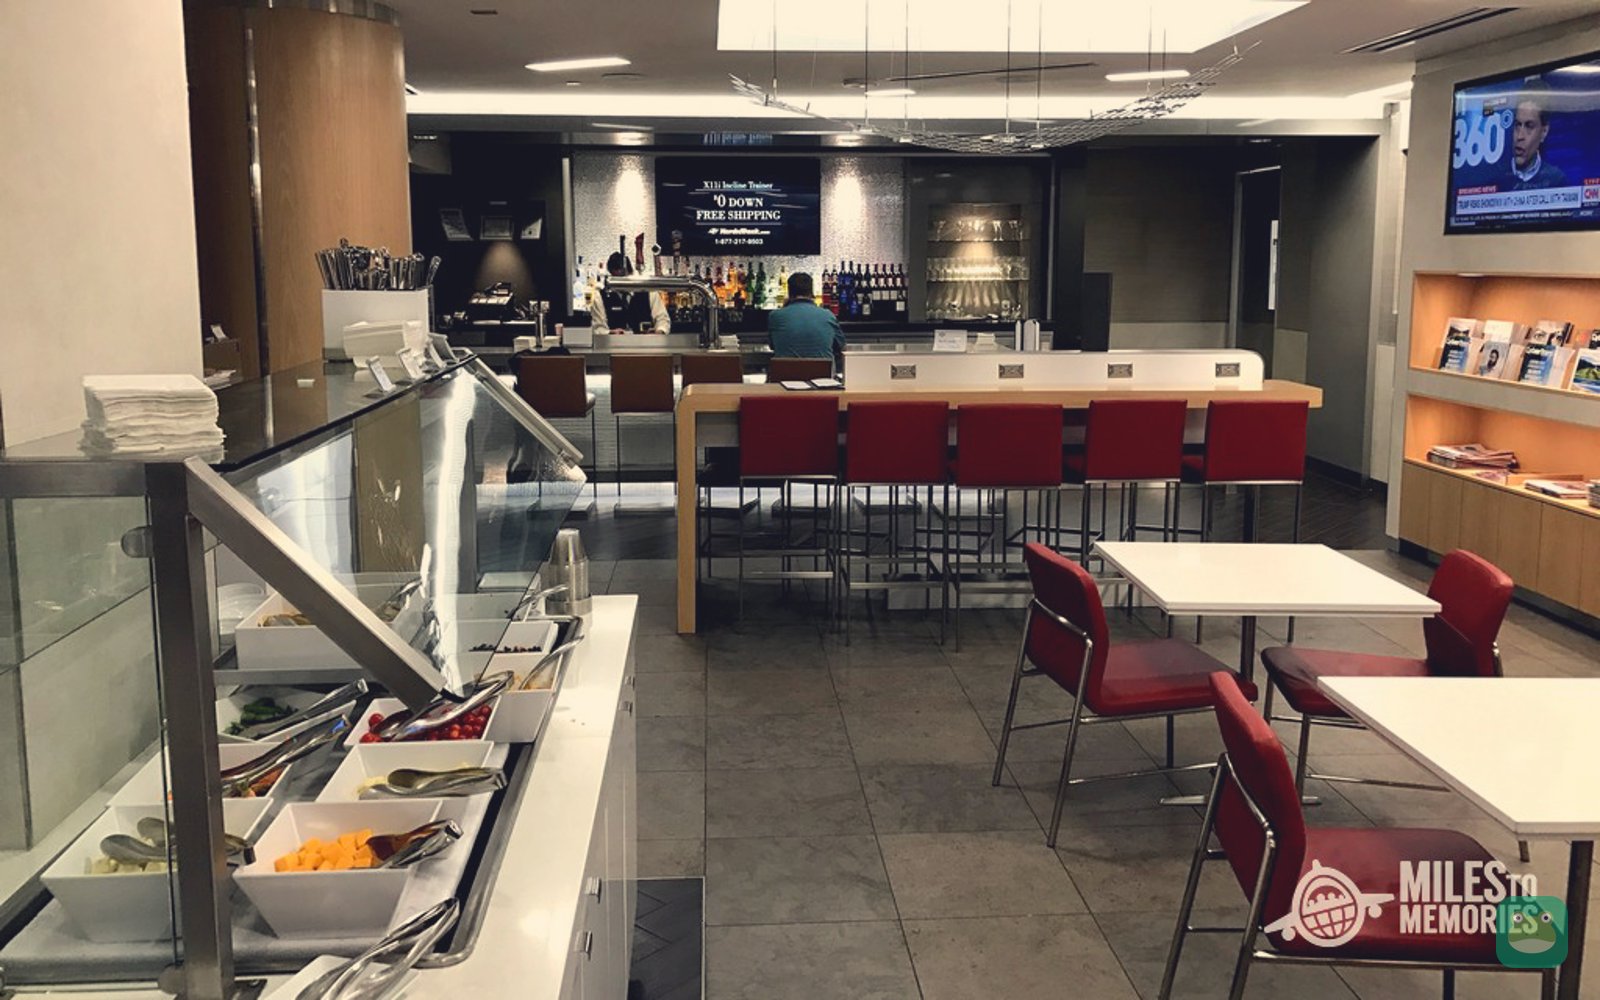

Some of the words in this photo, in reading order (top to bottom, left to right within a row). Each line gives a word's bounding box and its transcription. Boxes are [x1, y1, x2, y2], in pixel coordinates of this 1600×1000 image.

[723, 181, 747, 189] Incline
[748, 181, 773, 189] Trainer
[729, 198, 763, 207] DOWN
[696, 210, 726, 220] FREE
[728, 210, 781, 220] SHIPPING
